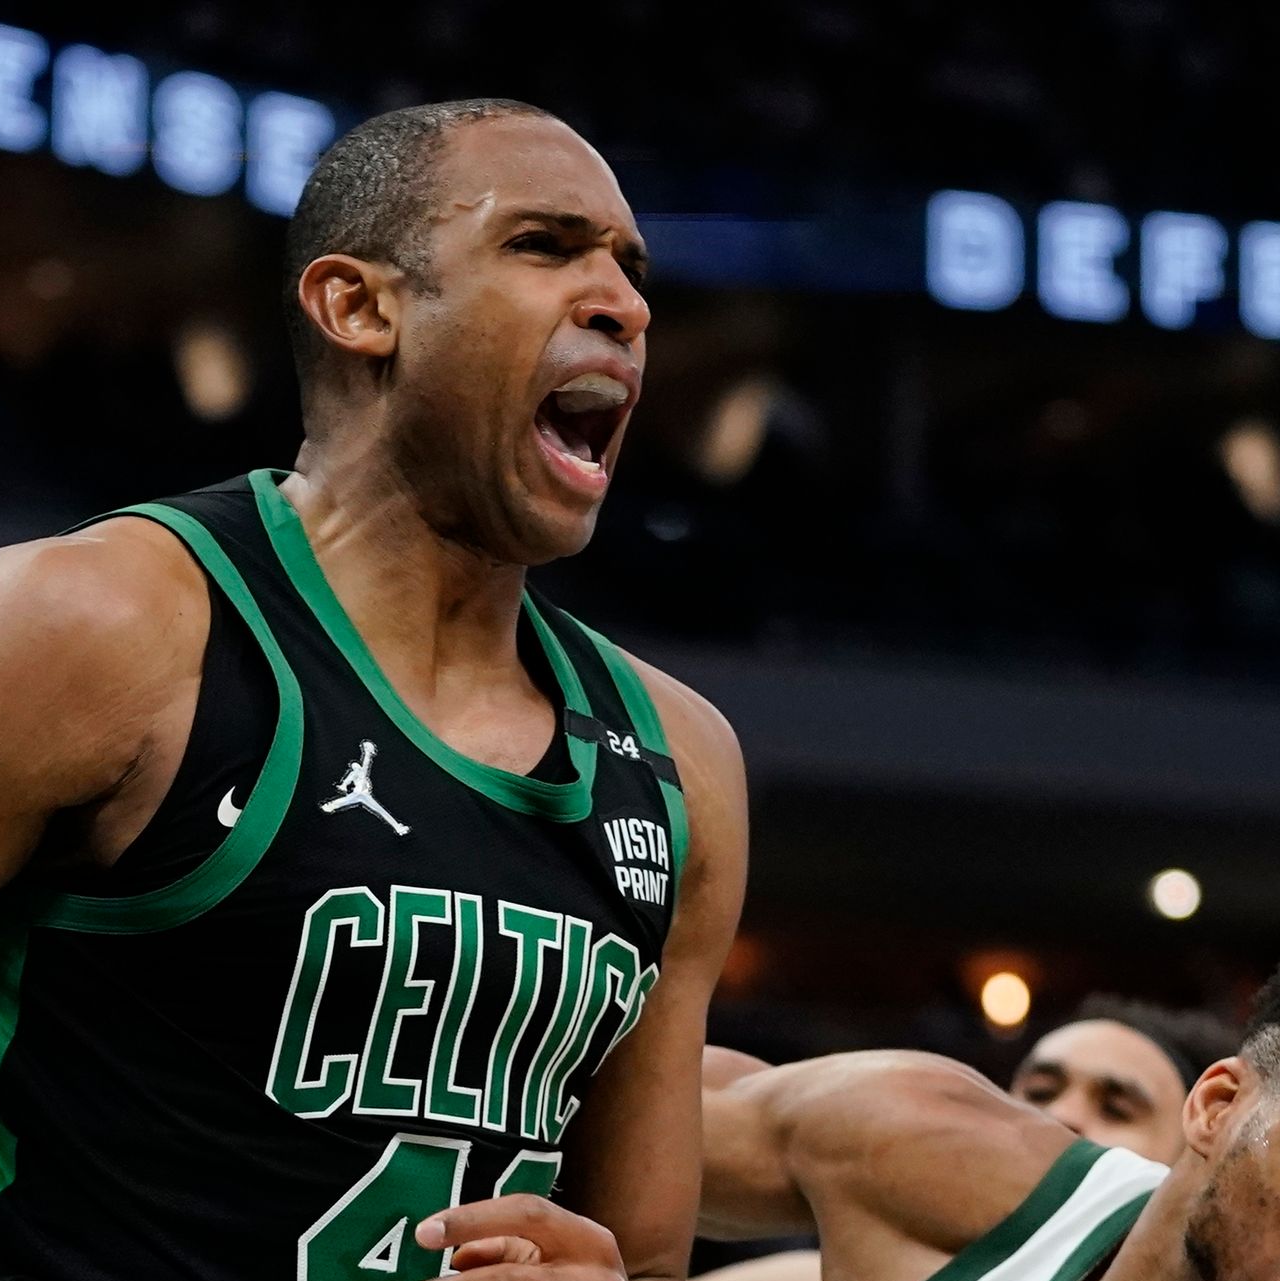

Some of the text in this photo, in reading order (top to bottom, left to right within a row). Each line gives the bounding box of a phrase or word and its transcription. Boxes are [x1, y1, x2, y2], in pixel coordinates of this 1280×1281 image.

[606, 730, 641, 760] 24
[603, 818, 669, 871] VISTA
[614, 866, 669, 906] PRINT
